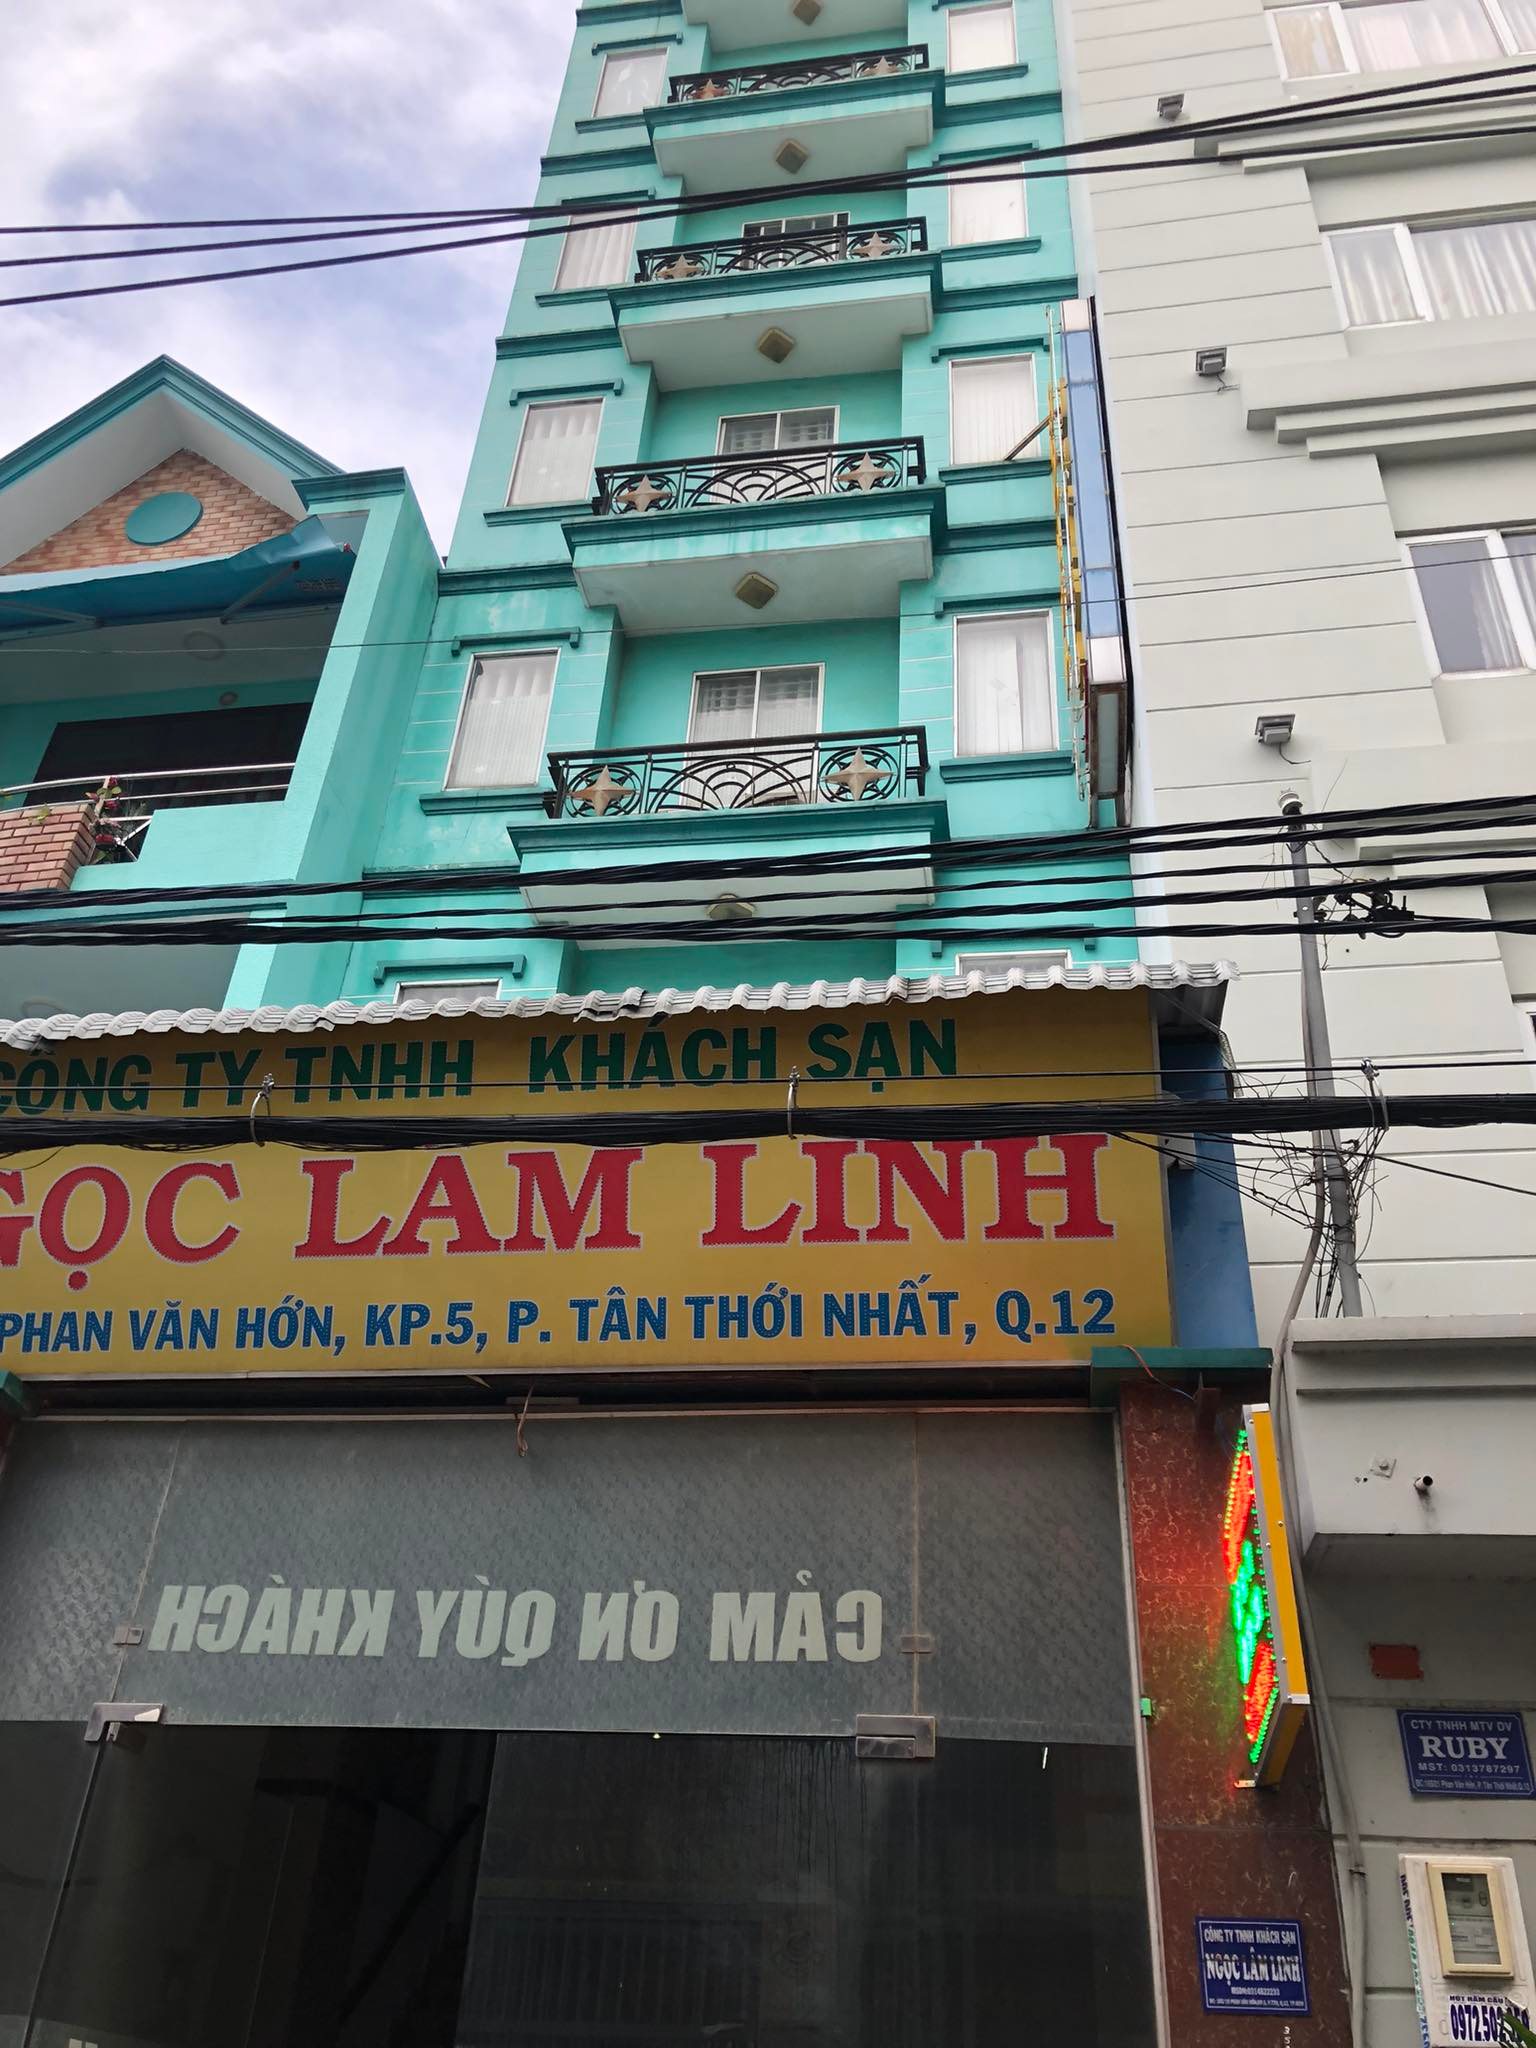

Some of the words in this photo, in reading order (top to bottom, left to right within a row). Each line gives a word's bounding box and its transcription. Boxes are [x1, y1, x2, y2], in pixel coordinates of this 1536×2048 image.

[175, 1048, 262, 1108] TY
[284, 1039, 474, 1104] TNHH
[528, 1015, 777, 1093] KHÁCH
[807, 1018, 957, 1093] SẠN
[701, 1134, 1116, 1247] LINH
[0, 1310, 112, 1353] PHAN
[130, 1300, 219, 1352] VĂN
[235, 1294, 346, 1357] HỚN,
[365, 1302, 488, 1354] KP.5,
[507, 1300, 552, 1345] P.
[569, 1286, 667, 1342] TÂN
[683, 1282, 803, 1341] THỚI
[823, 1273, 977, 1346] NHẤT,
[996, 1289, 1116, 1344] Q.12
[1410, 1719, 1433, 1730] CTY
[1436, 1720, 1468, 1731] TNHH
[1470, 1721, 1494, 1732] MTV
[1419, 1735, 1509, 1760] RUBY
[1224, 1929, 1234, 1943] TY
[1205, 1953, 1241, 1986] NGỌC
[1270, 1955, 1302, 1982] LINH
